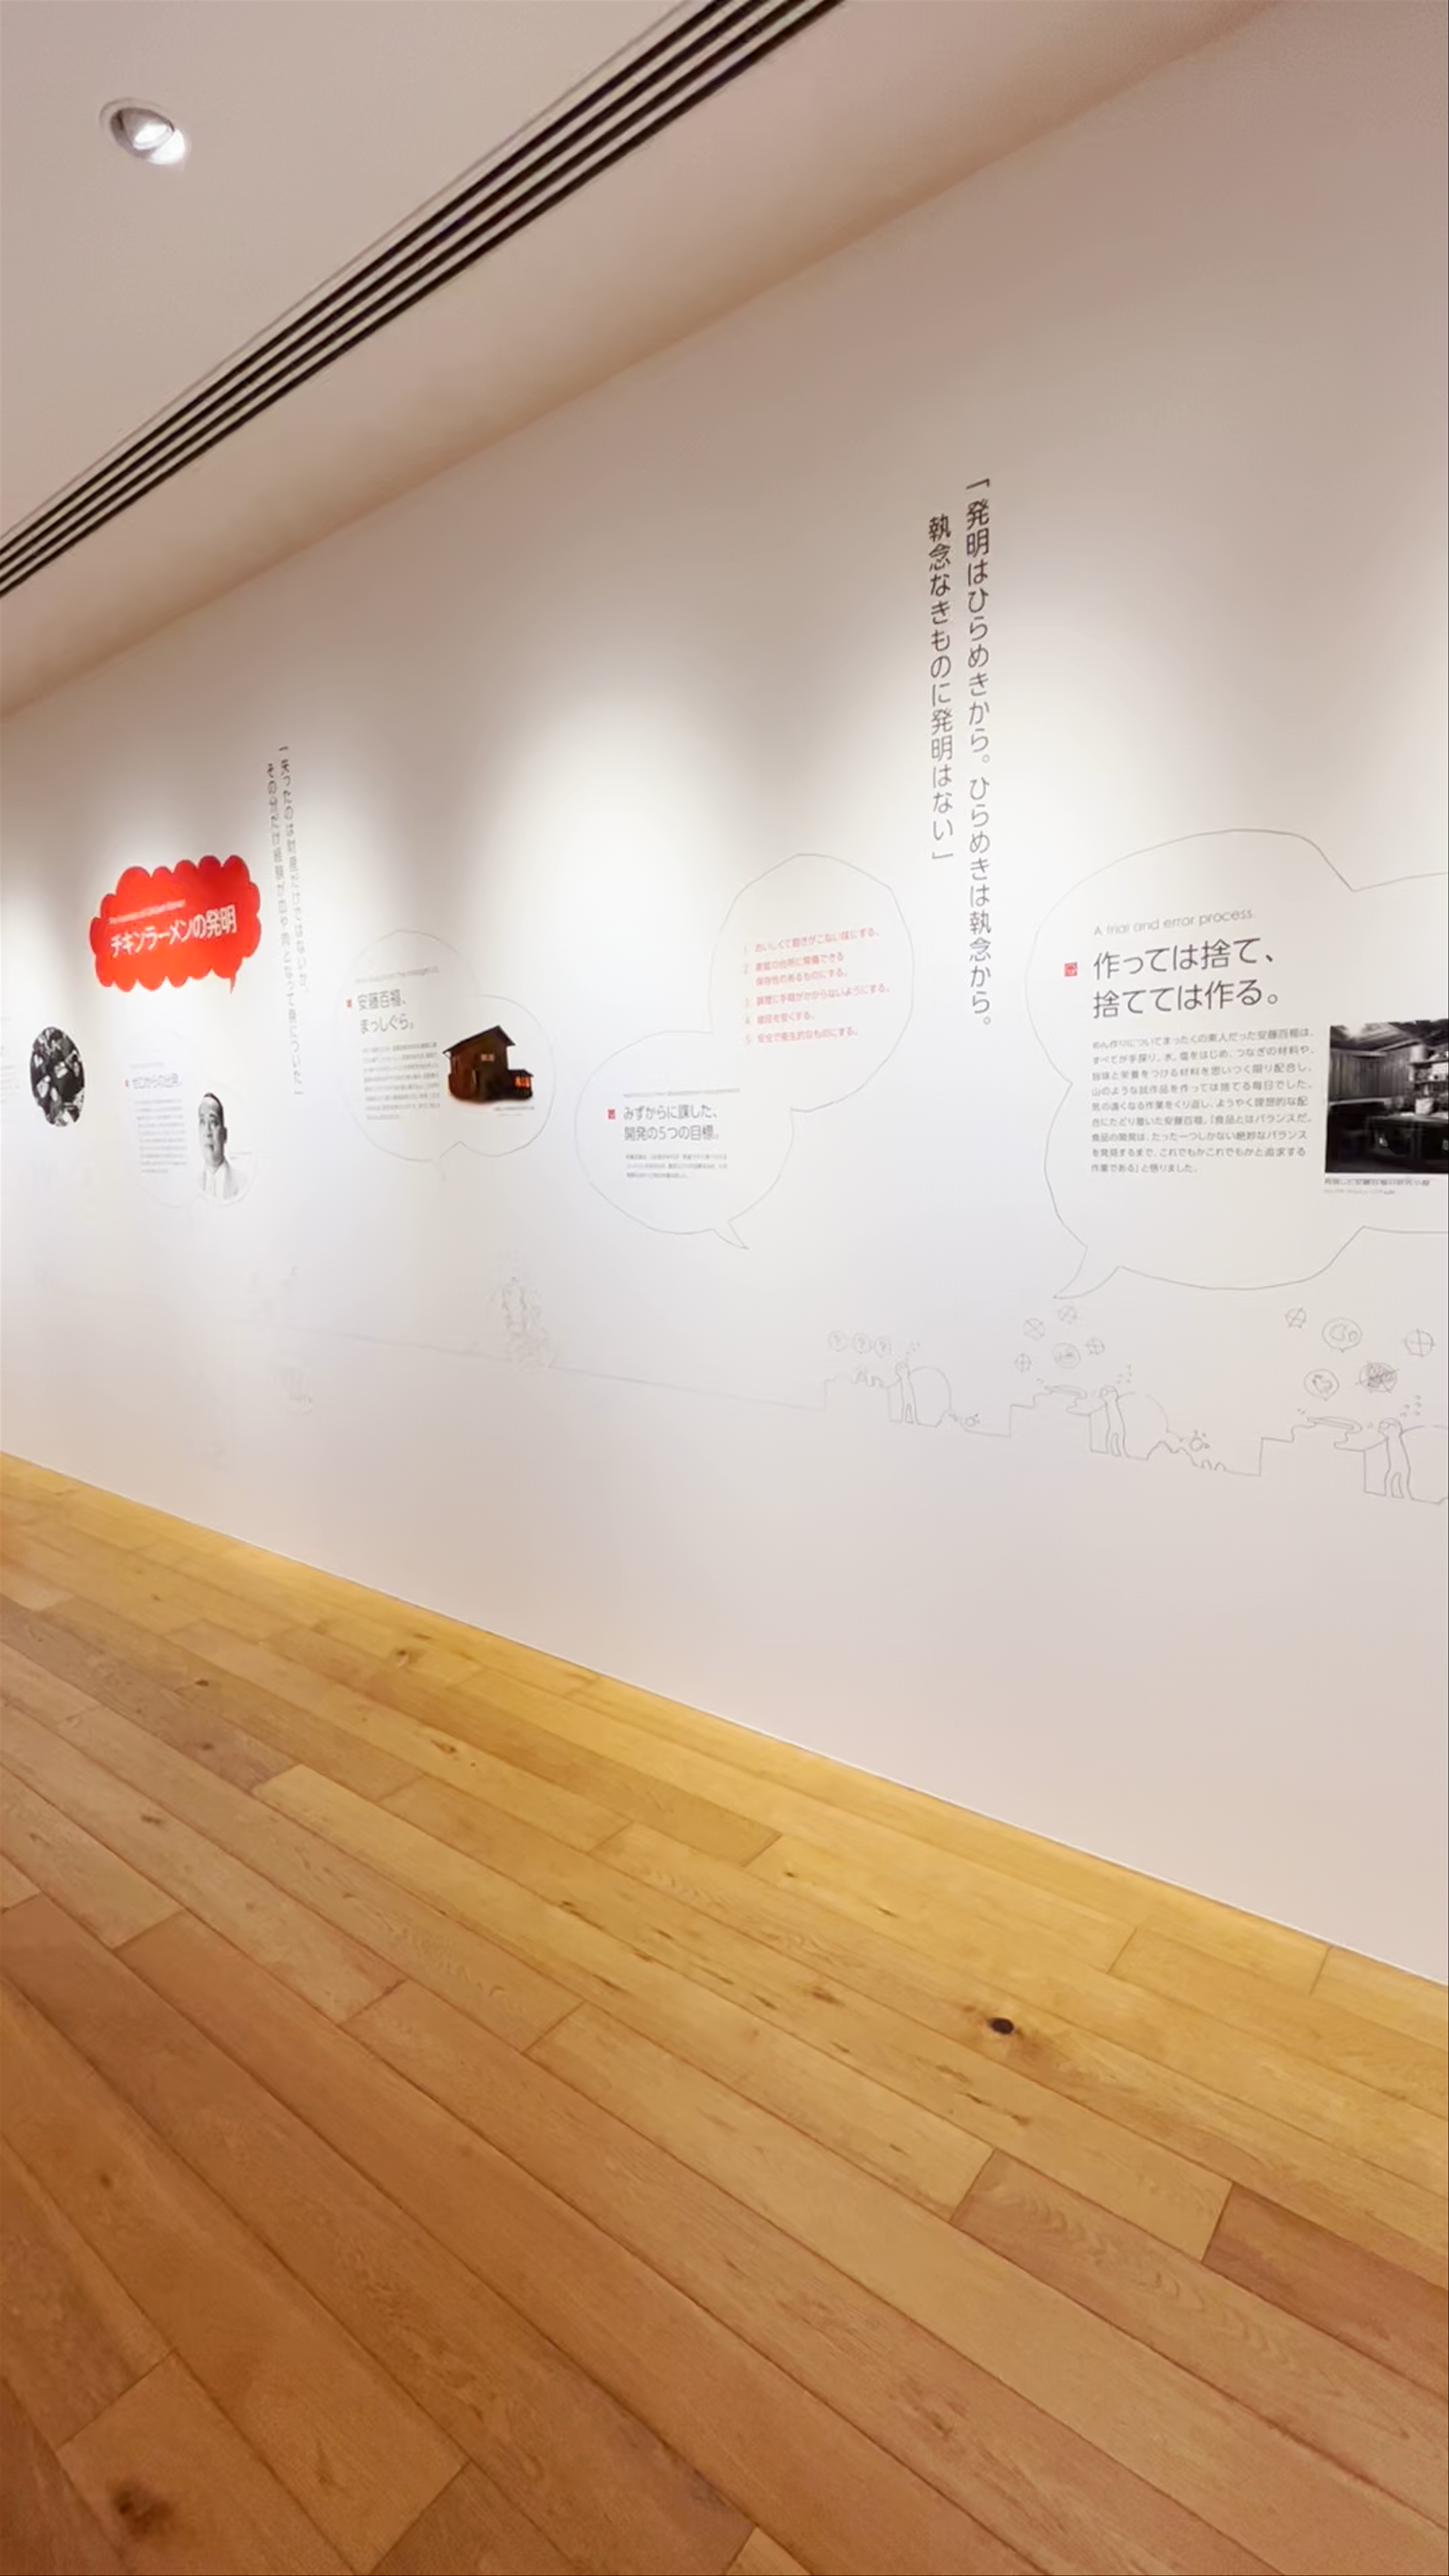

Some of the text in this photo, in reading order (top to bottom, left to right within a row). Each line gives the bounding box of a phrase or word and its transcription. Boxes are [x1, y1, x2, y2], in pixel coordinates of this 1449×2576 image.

[928, 512, 954, 860] 執念なきものに発明はない」
[966, 478, 991, 1025] 「発明はひらめきから。ひらめきは執念から。
[111, 904, 237, 958] チキンラーメンの発明
[1094, 908, 1256, 935] A trial and error process.
[1093, 937, 1274, 981] 作っては捨て、
[1093, 978, 1278, 1019] 捨てては作る。
[624, 1104, 718, 1120] みずからに課した、
